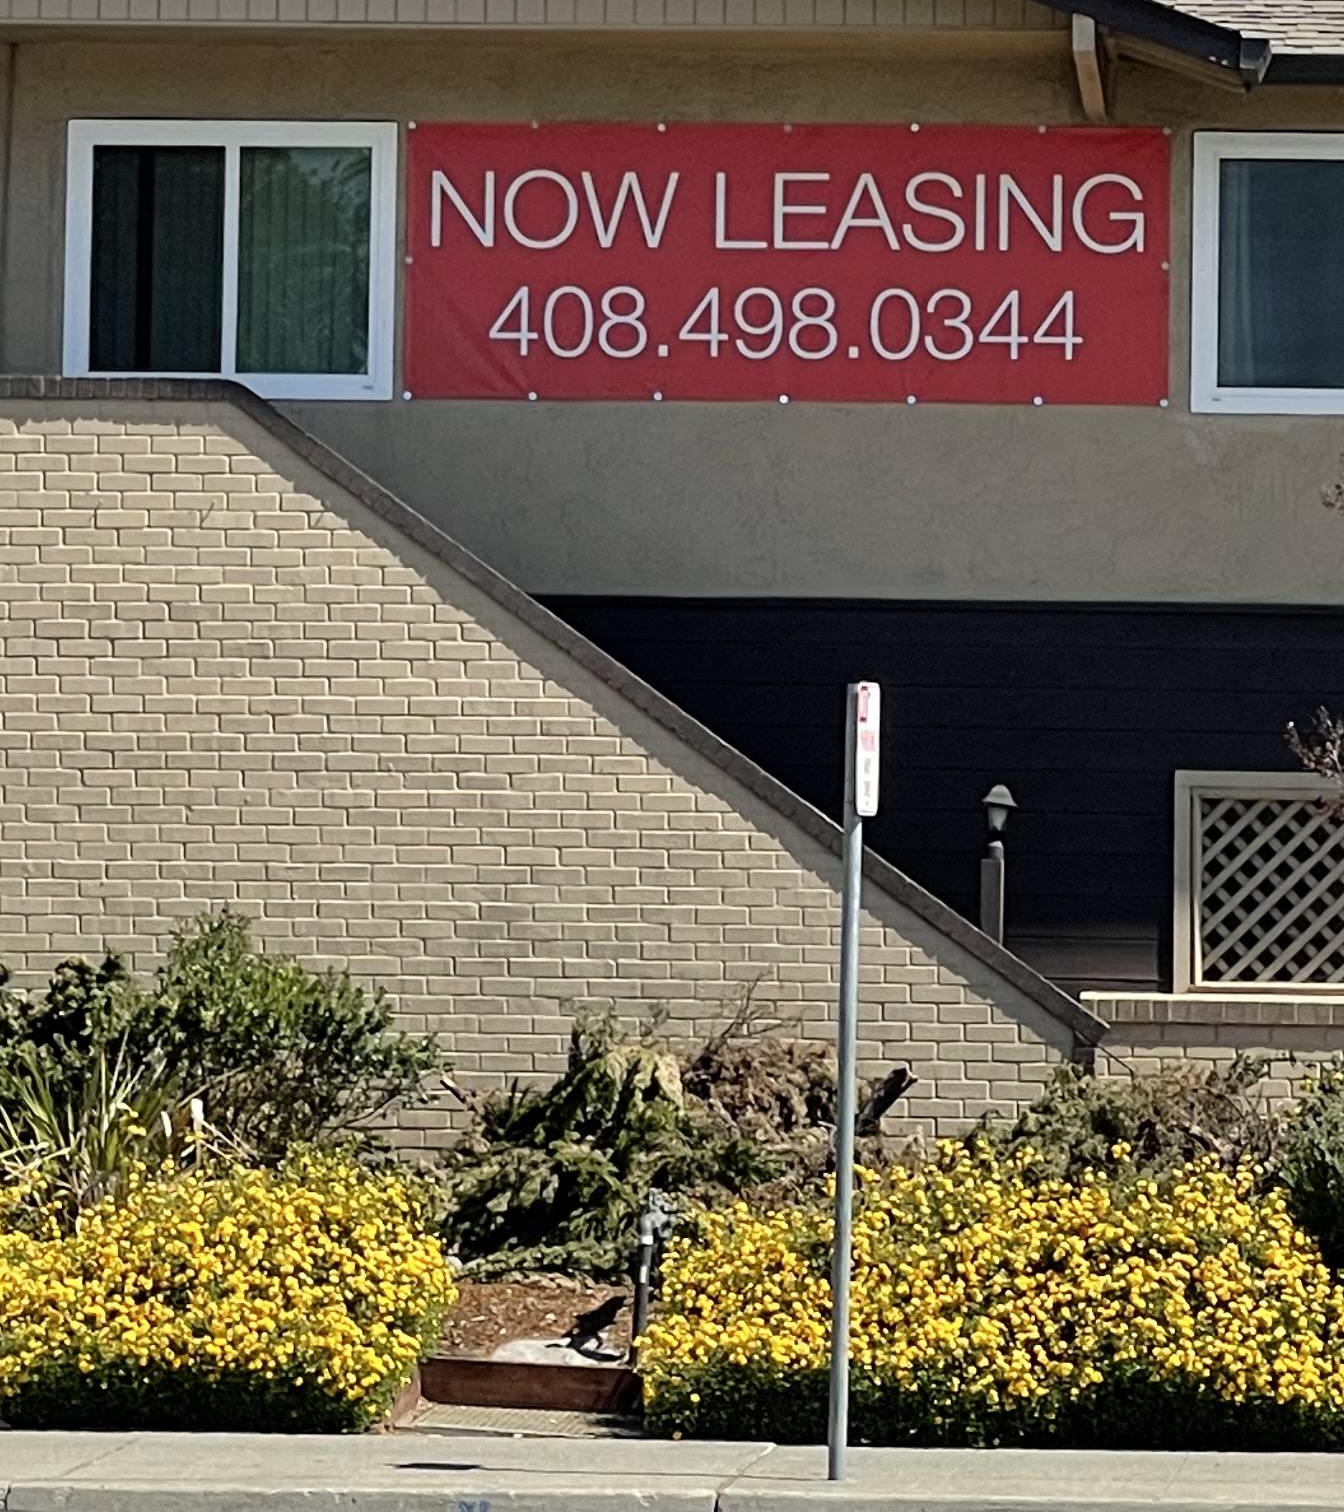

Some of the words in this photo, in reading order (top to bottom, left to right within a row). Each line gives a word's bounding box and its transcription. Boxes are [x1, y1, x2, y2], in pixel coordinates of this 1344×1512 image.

[429, 168, 679, 249] NOW
[715, 171, 1145, 254] LEASING
[488, 285, 1083, 361] 408.498.0344
